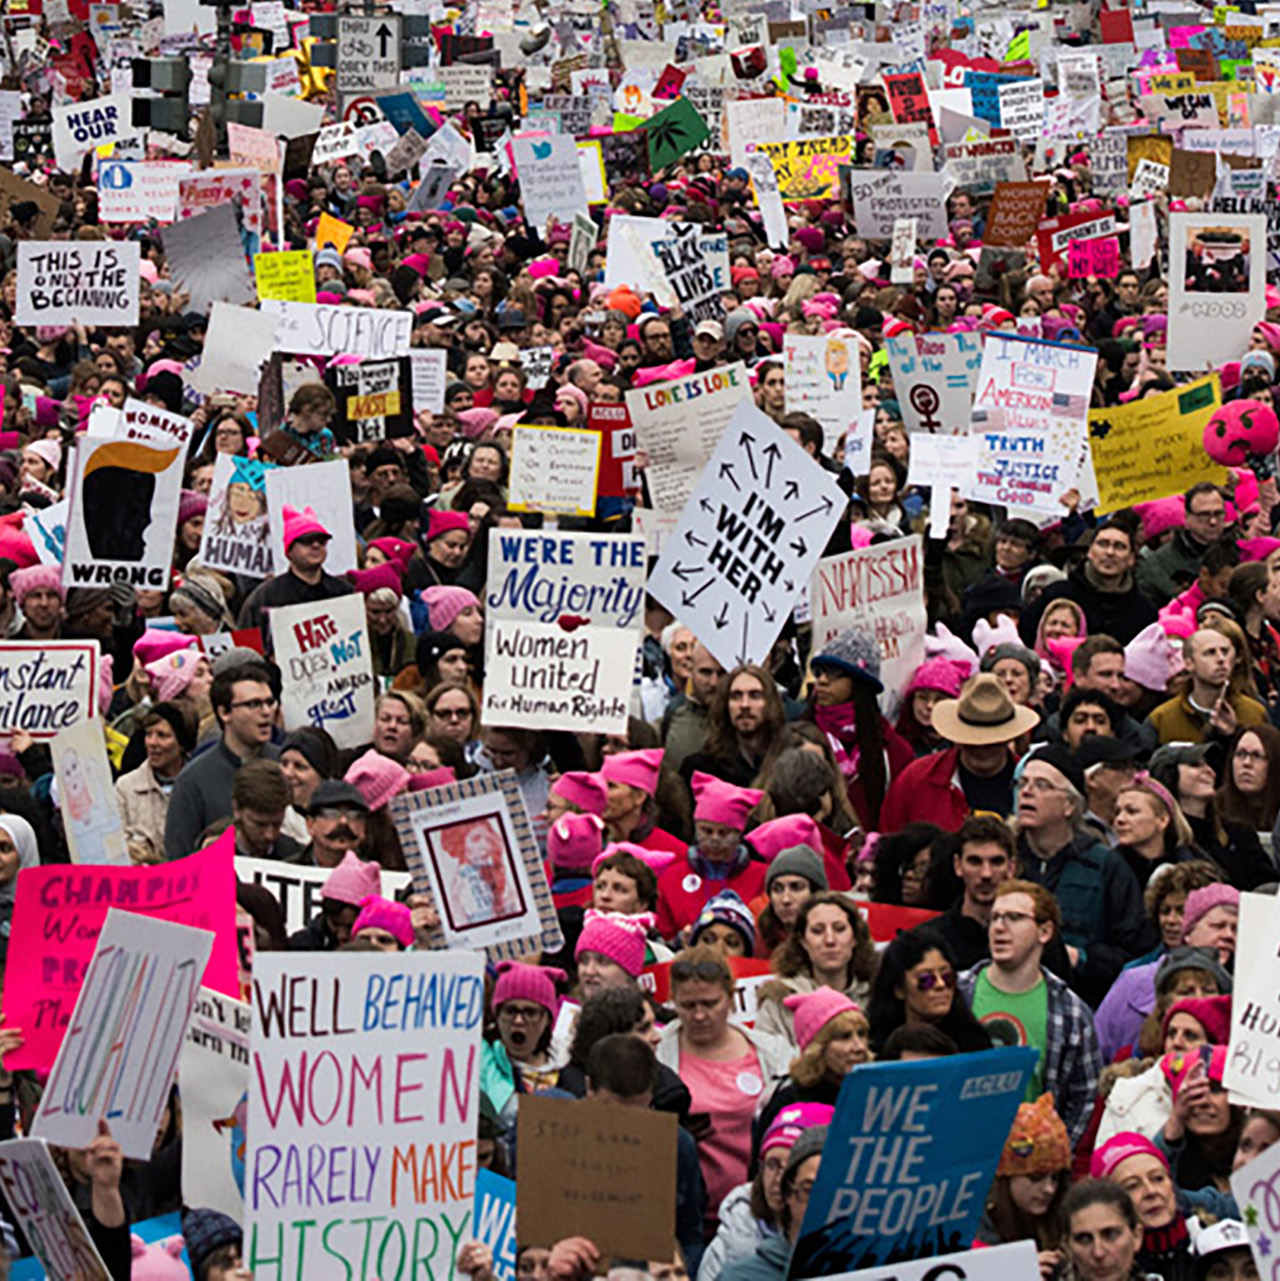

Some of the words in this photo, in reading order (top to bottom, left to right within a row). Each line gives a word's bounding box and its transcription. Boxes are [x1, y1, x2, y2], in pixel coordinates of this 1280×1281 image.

[341, 22, 369, 34] THRU
[340, 60, 368, 71] OBEY
[372, 60, 396, 71] THIS
[339, 76, 376, 88] SIGNAL
[67, 106, 117, 129] HEAR
[74, 119, 117, 142] OUR
[997, 199, 1040, 212] WON'T
[1213, 198, 1251, 214] HELL
[990, 224, 1033, 238] DOWN
[30, 251, 82, 275] THIS
[93, 248, 119, 270] IS
[34, 271, 82, 293] ONLY
[83, 267, 127, 291] THE
[671, 266, 713, 302] LIVES
[30, 285, 130, 313] BEGINNING
[1178, 301, 1248, 319] #MOOD
[995, 341, 1010, 360] I
[1022, 342, 1079, 368] MARCH
[645, 387, 683, 410] LOVE
[686, 379, 702, 401] IS
[704, 370, 740, 394] LOVE
[1016, 369, 1047, 386] FOR
[593, 406, 625, 420] ACLU
[985, 435, 1044, 452] TRUTH
[991, 460, 1060, 479] JUSTICE
[742, 491, 787, 545] I'M
[717, 503, 786, 586] WITH
[72, 564, 165, 588] WRONG
[707, 545, 764, 604] HER
[819, 545, 918, 616] NARCISSISM
[487, 562, 645, 625] Majority
[252, 974, 356, 1039] WELL
[361, 972, 484, 1032] BEHAVED
[253, 1045, 475, 1128] WOMEN
[861, 1085, 938, 1134] WE
[846, 1136, 931, 1185] THE
[252, 1143, 380, 1210] RARELY
[390, 1139, 475, 1206] MAKE
[828, 1172, 982, 1236] PEOPLE
[249, 1210, 473, 1281] HISTORY
